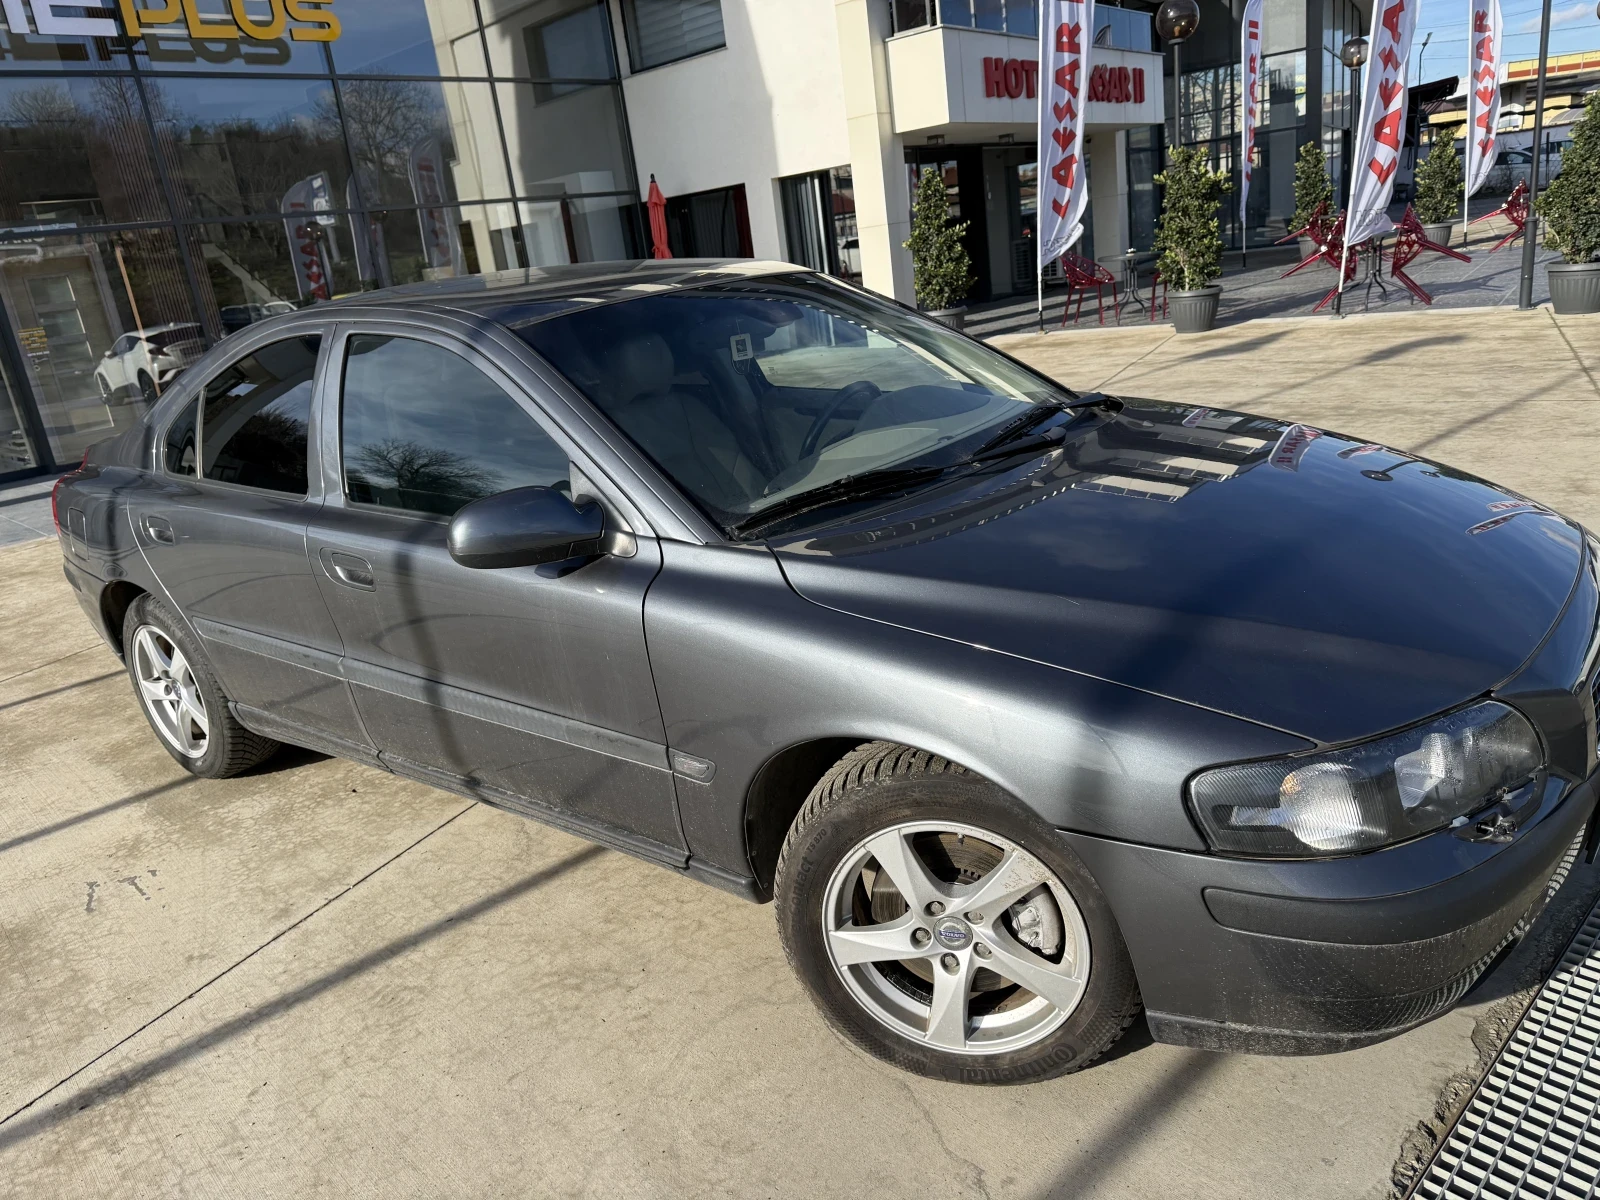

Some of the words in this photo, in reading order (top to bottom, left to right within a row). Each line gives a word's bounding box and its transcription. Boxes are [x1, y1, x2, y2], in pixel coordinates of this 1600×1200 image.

[119, 0, 341, 41] PLUS
[983, 57, 1039, 98] HOT
[1133, 67, 1145, 103] II
[1368, 1, 1405, 186] CAESA
[814, 828, 827, 844] 870
[958, 1042, 1078, 1084] Continental
